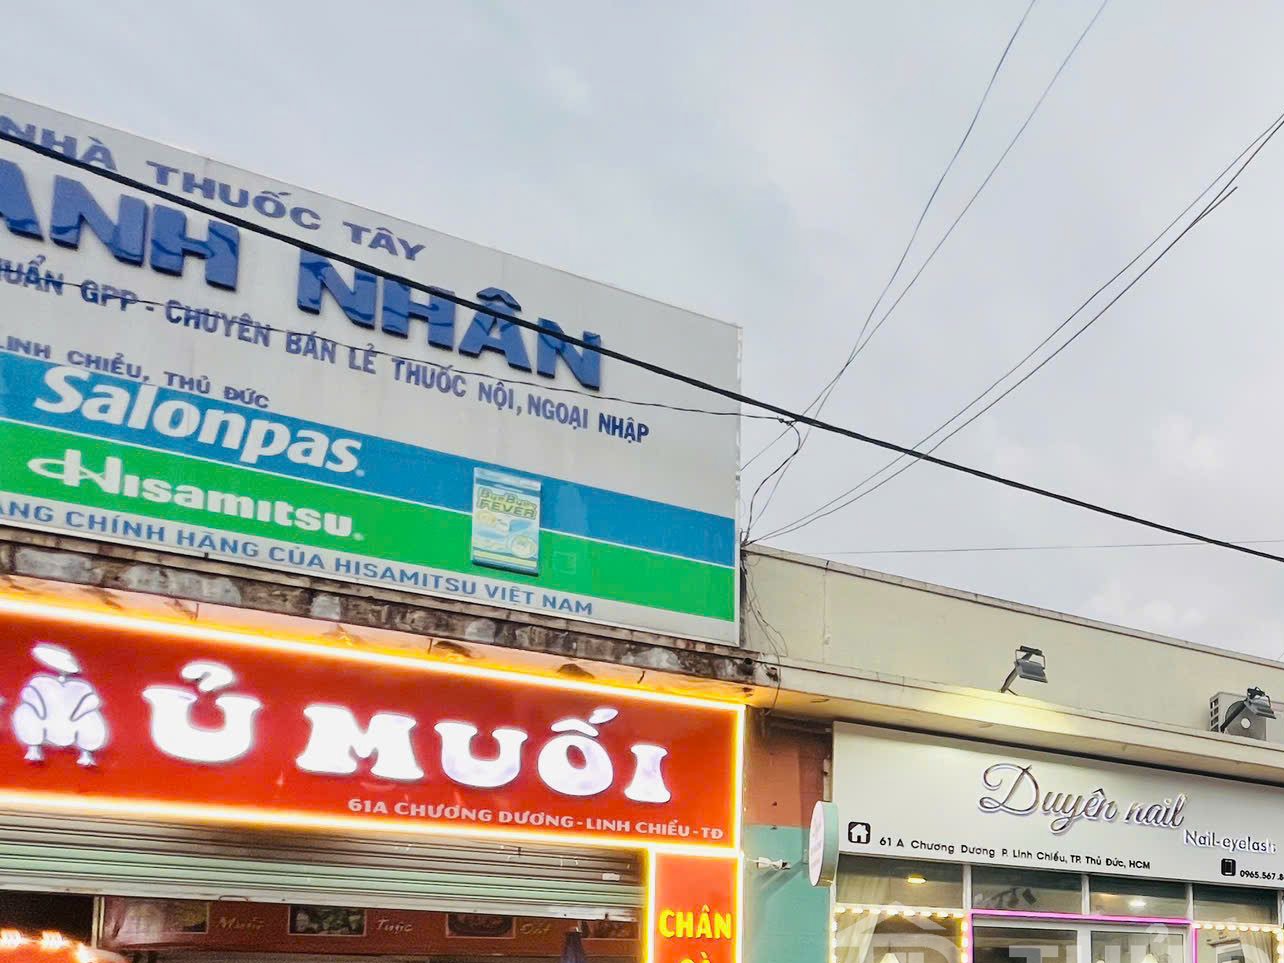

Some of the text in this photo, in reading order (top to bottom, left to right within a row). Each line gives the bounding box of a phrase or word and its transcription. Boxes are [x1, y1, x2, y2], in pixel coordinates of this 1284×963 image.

[0, 114, 426, 262] NHÀ THUỐC TÂY
[0, 254, 64, 296] UẨN
[80, 278, 138, 312] GPP
[164, 299, 272, 348] CHUYÊN
[286, 331, 337, 366] BÁN
[348, 343, 377, 375] LẺ
[391, 358, 467, 398] THUỐC
[527, 393, 589, 431] NGOẠI
[598, 412, 650, 445] NHẬP
[297, 249, 601, 391] NHÂN
[0, 336, 51, 360] INH
[164, 370, 210, 395] THỦ
[223, 384, 270, 409] ĐỨC
[33, 366, 363, 473] Salonpas
[27, 448, 353, 538] Hisamitsu
[66, 511, 164, 543] CHÍNH
[268, 545, 325, 570] CỦA
[334, 556, 477, 595] HISAMITSU
[485, 583, 534, 606] VIỆT
[542, 595, 593, 616] NAM
[142, 660, 672, 803] Ủ MUỐI
[348, 799, 388, 814] 61A
[394, 801, 493, 822] CHƯƠNG
[498, 810, 573, 829] DƯƠNG
[586, 817, 631, 832] LINH
[701, 827, 724, 839] TĐ
[979, 763, 1188, 834] Duyên nail
[880, 837, 892, 846] 61
[896, 838, 904, 847] A
[1013, 850, 1032, 859] Linh
[1129, 860, 1150, 869] HCM
[659, 904, 732, 939] CHÂN
